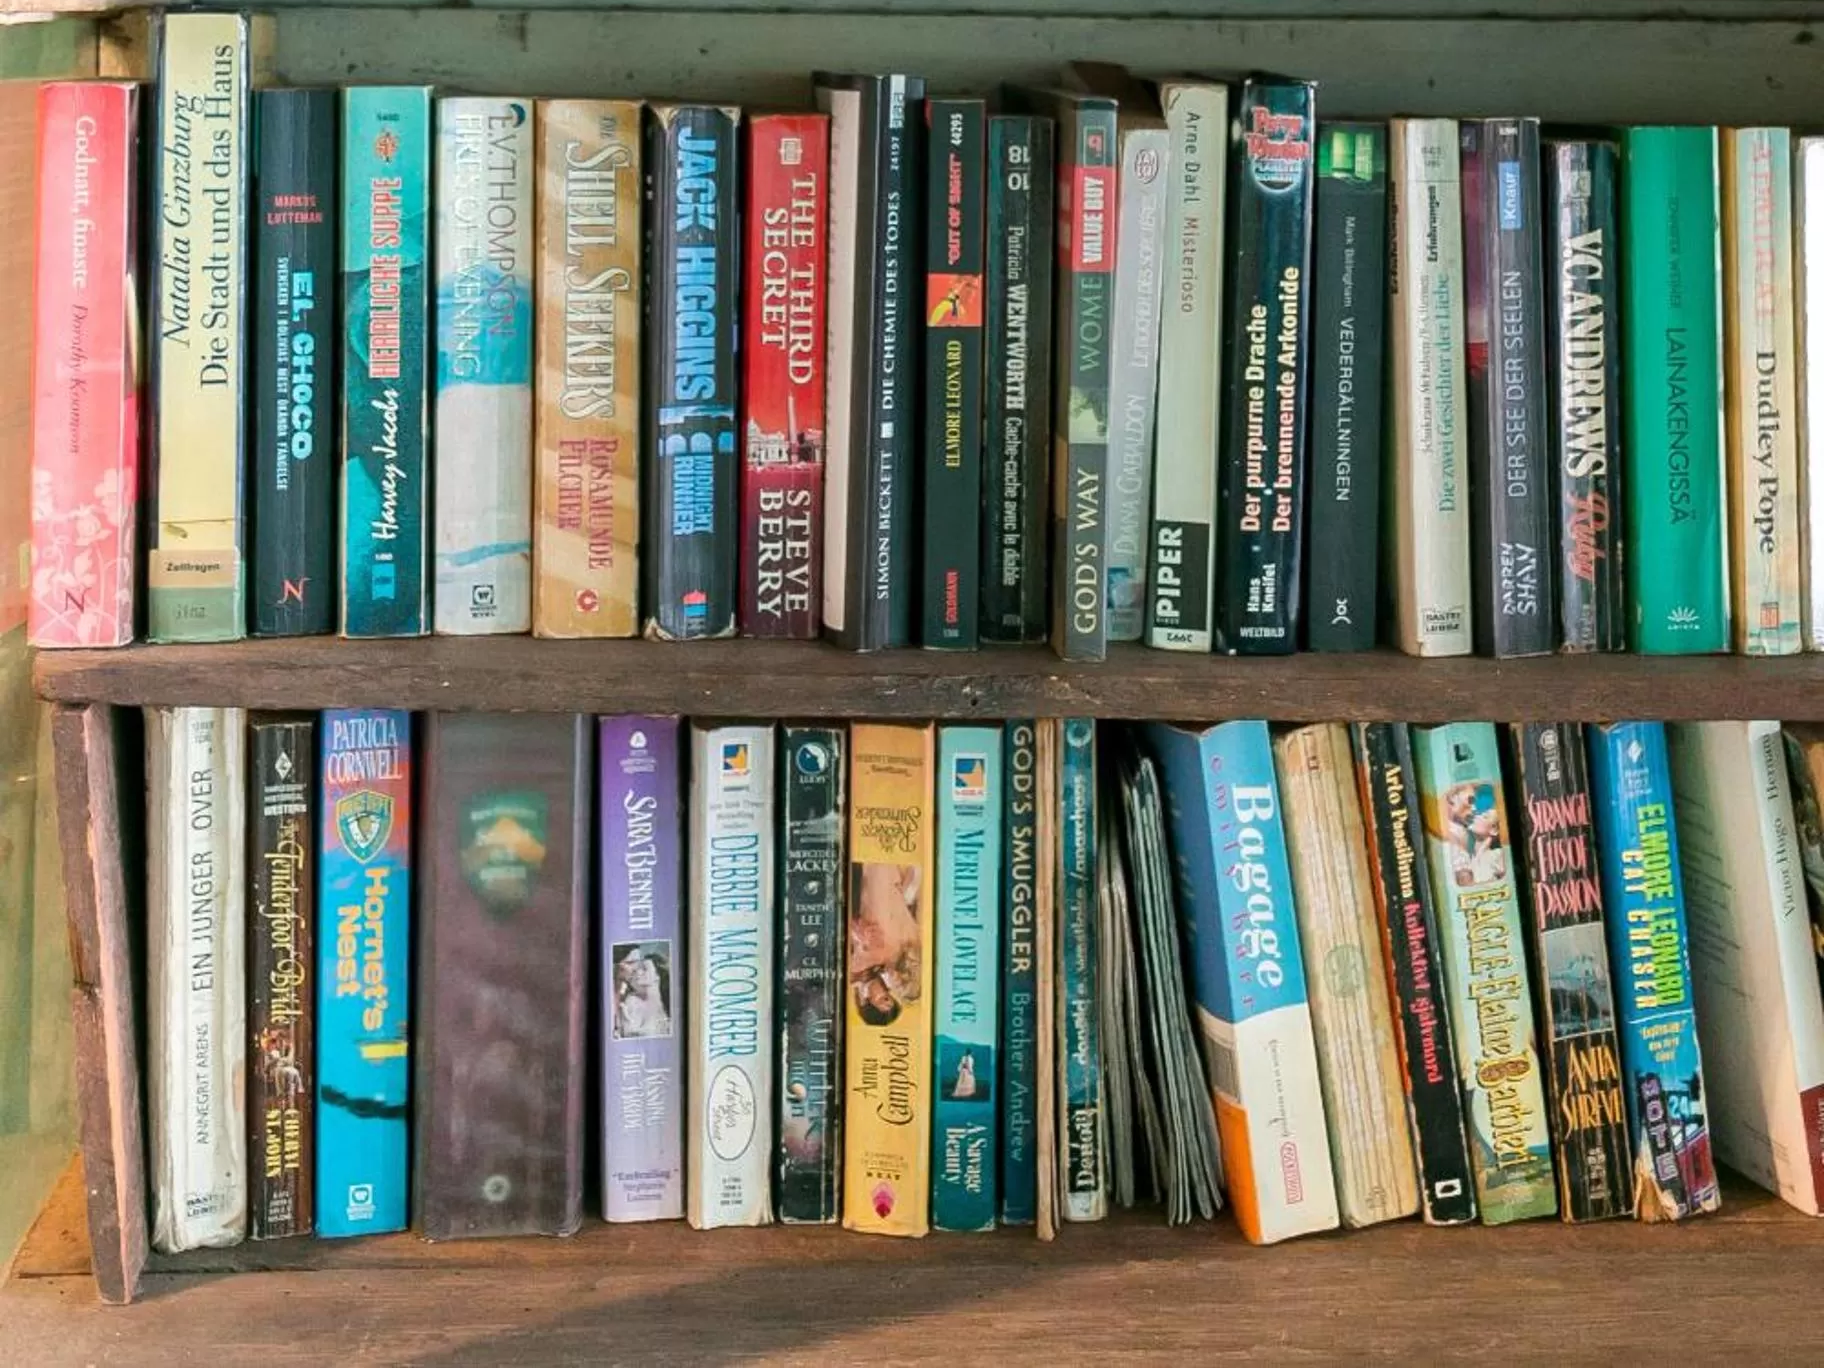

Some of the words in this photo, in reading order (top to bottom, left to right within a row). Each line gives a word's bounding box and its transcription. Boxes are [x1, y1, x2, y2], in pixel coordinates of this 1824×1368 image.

[203, 44, 233, 121] Haus
[162, 89, 203, 229] Ginzburg
[203, 129, 232, 177] das
[950, 113, 963, 147] 44295
[203, 180, 231, 246] und
[563, 140, 632, 256] SHELL
[676, 127, 717, 231] JACK
[790, 171, 817, 248] THE
[1083, 176, 1105, 211] BUY
[1503, 170, 1518, 221] Knaur
[71, 219, 93, 288] finaste
[1007, 225, 1024, 280] Patricia
[1081, 214, 1104, 263] VALUE
[1344, 216, 1356, 246] Mark
[1425, 184, 1439, 263] Erfahrungen
[162, 237, 192, 349] Natalia
[201, 252, 231, 330] Stadt
[761, 205, 788, 350] SECRET
[1180, 217, 1200, 314] Misterioso
[1340, 249, 1355, 308] Billingham
[1432, 273, 1451, 322] Liebe
[276, 319, 289, 363] BOLIVIAS
[560, 264, 631, 421] SEEKERS
[675, 247, 716, 401] HIGGINS
[788, 263, 815, 385] THIRD
[1004, 283, 1028, 410] WENTWORTH
[1244, 304, 1267, 382] Drache
[1277, 265, 1300, 368] Arkonide
[1434, 325, 1452, 359] der
[1501, 271, 1524, 350] SEELEN
[199, 337, 230, 389] Die
[276, 367, 289, 394] MEST
[945, 340, 962, 409] LEONARD
[1435, 362, 1456, 439] Gesichter
[1504, 358, 1526, 401] DER
[371, 387, 401, 459] Jacobs
[944, 411, 962, 468] ELMORE
[1243, 386, 1269, 489] purpurne
[1273, 371, 1297, 489] brennende
[1335, 316, 1358, 502] VEDERGÄLLNINGEN
[1505, 407, 1527, 448] SEE
[1665, 326, 1696, 524] LAINAKENGISSÄ
[557, 438, 587, 531] PILCHER
[673, 455, 693, 536] RUNNER
[1437, 440, 1457, 480] zwei
[1437, 482, 1457, 513] Die
[1506, 454, 1528, 497] DER
[375, 463, 407, 540] Harvey
[588, 438, 619, 570] ROSAMUNDE
[1240, 492, 1263, 532] Der
[1272, 493, 1294, 532] Der
[1566, 489, 1610, 581] Ruby
[757, 487, 785, 619] BERRY
[785, 488, 812, 613] STEVE
[1156, 527, 1183, 617] PIPER
[1261, 563, 1277, 612] Kneifel
[945, 571, 959, 624] GOLDMANN
[1239, 626, 1286, 638] WELTBILD
[1246, 577, 1262, 612] Hans
[327, 746, 403, 783] CORNWELL
[332, 719, 398, 748] PATRICIA
[1384, 761, 1404, 805] Arto
[1527, 792, 1589, 836] STRANGE
[710, 832, 759, 916] DEBBIE
[786, 860, 838, 872] LACKEY
[953, 827, 985, 919] MERLINE
[1391, 808, 1416, 899] Paasilinna
[1621, 848, 1645, 902] CAT
[1636, 802, 1676, 901] ELMORE
[1771, 817, 1791, 865] Hugo
[262, 840, 306, 954] Tenderfoot
[800, 915, 823, 925] LEE
[1231, 783, 1284, 989] Bagage
[1534, 879, 1602, 930] PASSION
[336, 904, 363, 1000] Nest
[951, 923, 984, 1025] LOVELACE
[1626, 909, 1655, 1009] CHASER
[1647, 907, 1686, 1005] LEONARD
[269, 958, 306, 1024] Bride
[709, 928, 758, 1062] MACOMBER
[1476, 974, 1524, 1057] Elaine
[1010, 992, 1030, 1071] Brother
[1565, 1042, 1617, 1088] ANITA
[852, 1057, 879, 1099] Anna
[879, 1035, 918, 1127] Campbell
[1561, 1085, 1622, 1134] SHREVE
[1010, 1080, 1030, 1162] Andrew
